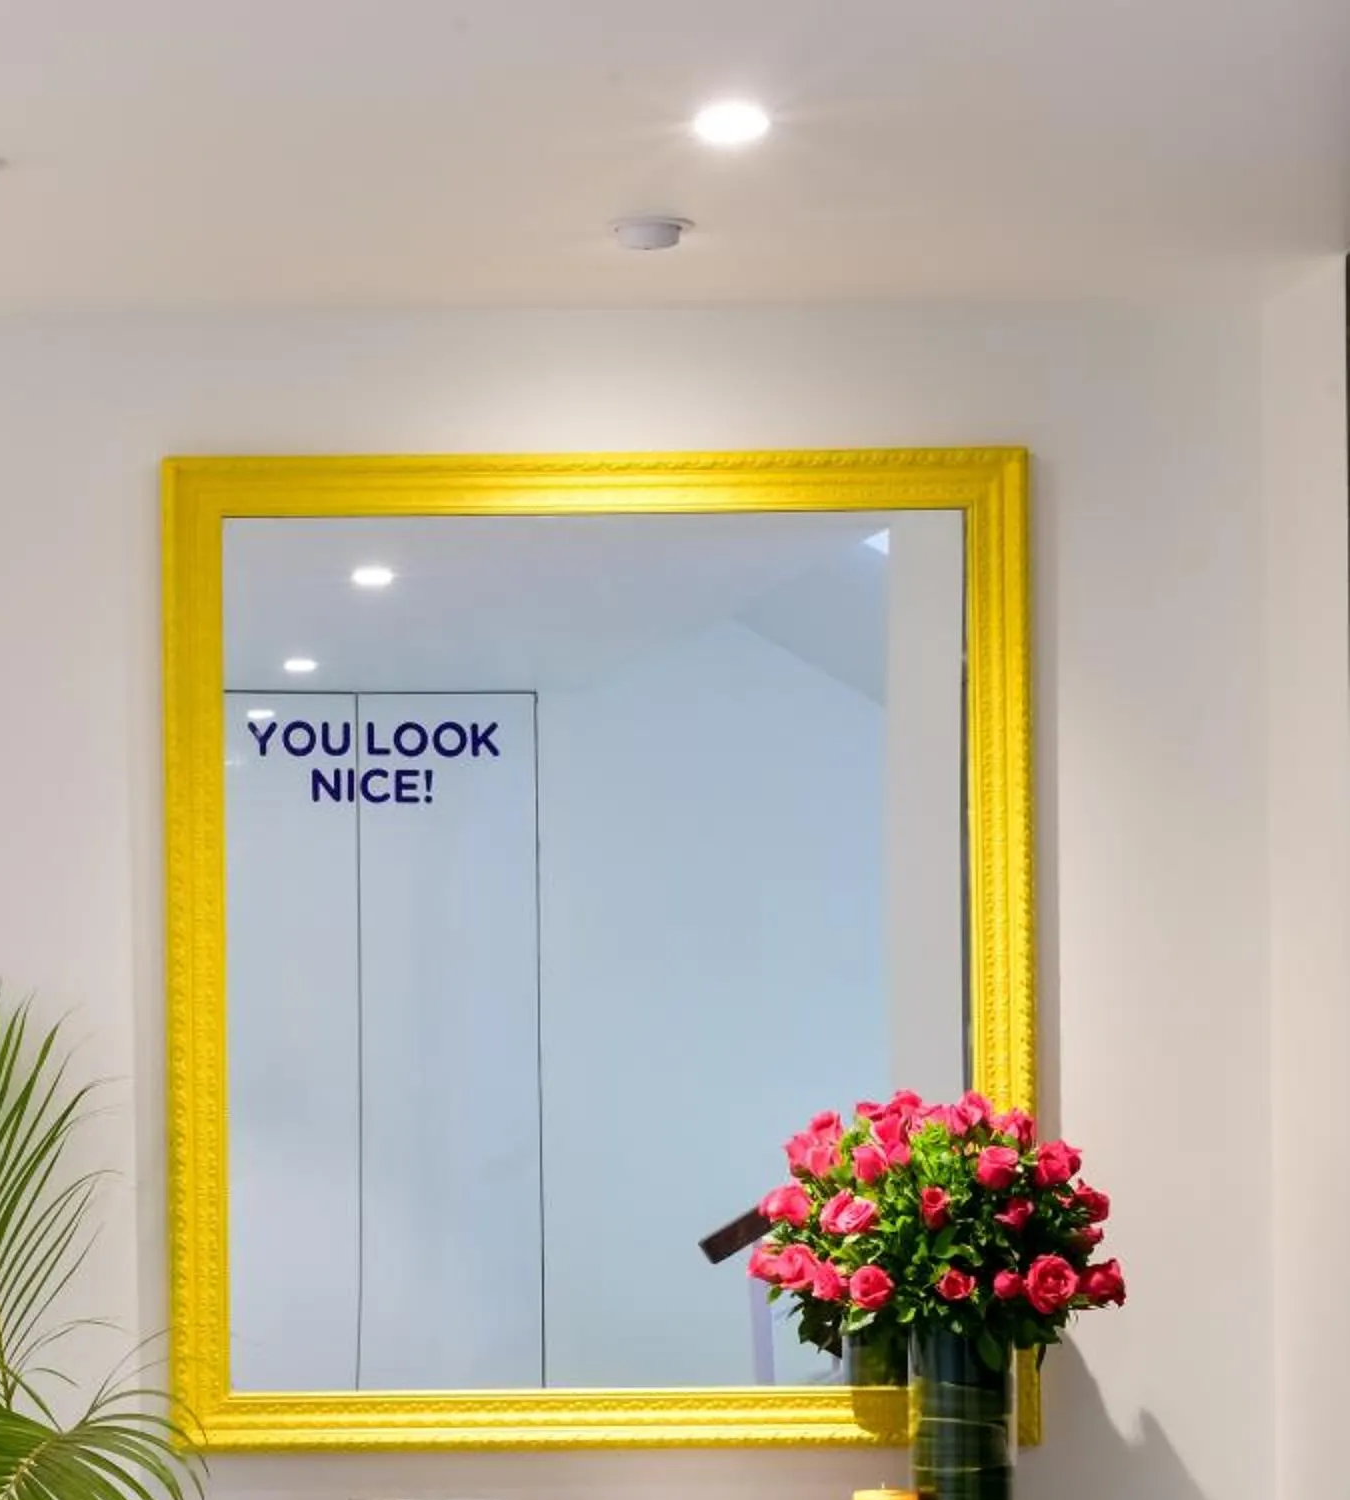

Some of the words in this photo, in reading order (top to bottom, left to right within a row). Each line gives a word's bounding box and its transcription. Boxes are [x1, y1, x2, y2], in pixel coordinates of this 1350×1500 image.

[248, 720, 351, 757] YOU
[366, 721, 500, 757] LOOK
[311, 767, 433, 803] NICE!
